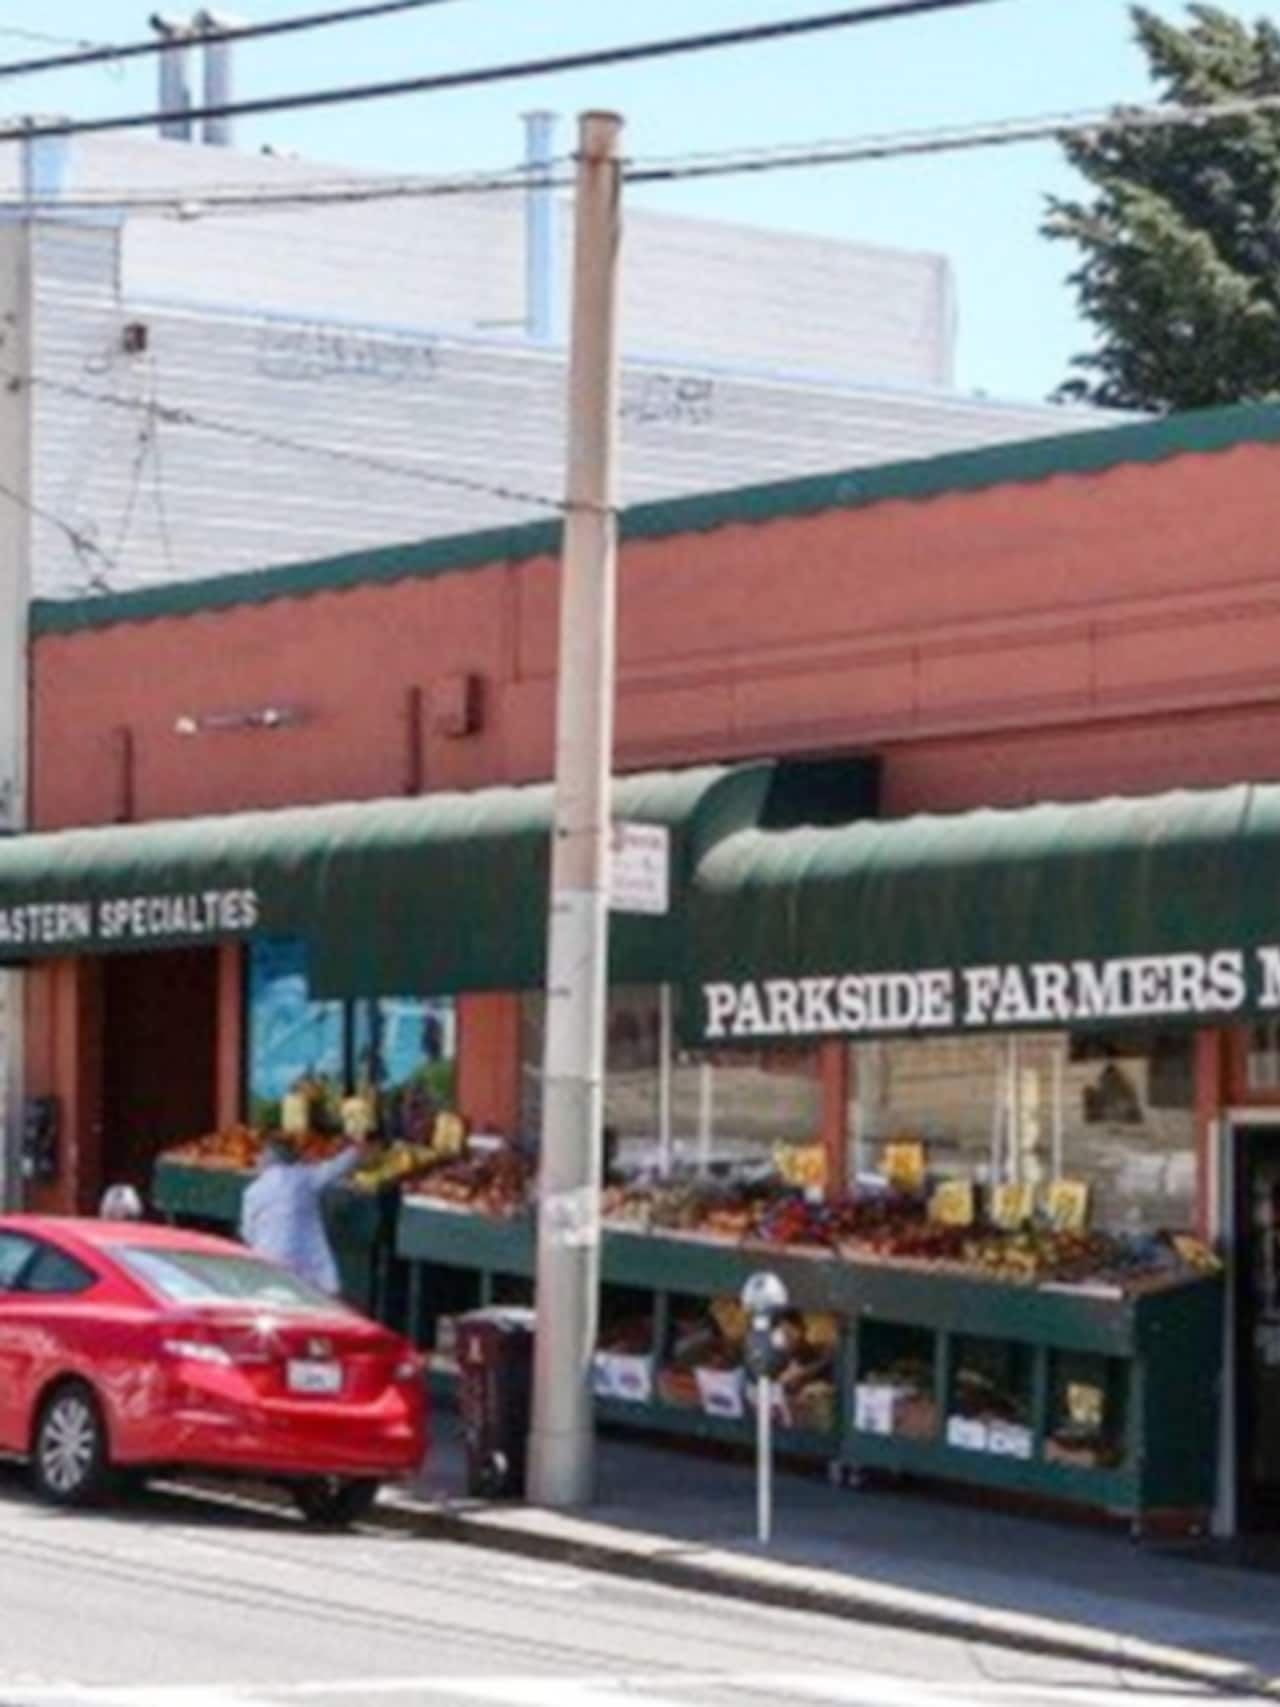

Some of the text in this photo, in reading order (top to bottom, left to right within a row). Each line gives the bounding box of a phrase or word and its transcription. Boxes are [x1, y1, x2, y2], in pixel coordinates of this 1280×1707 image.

[99, 889, 258, 938] SPECIALTIES
[704, 969, 954, 1038] PARKSIDE
[963, 949, 1246, 1024] FARMERS
